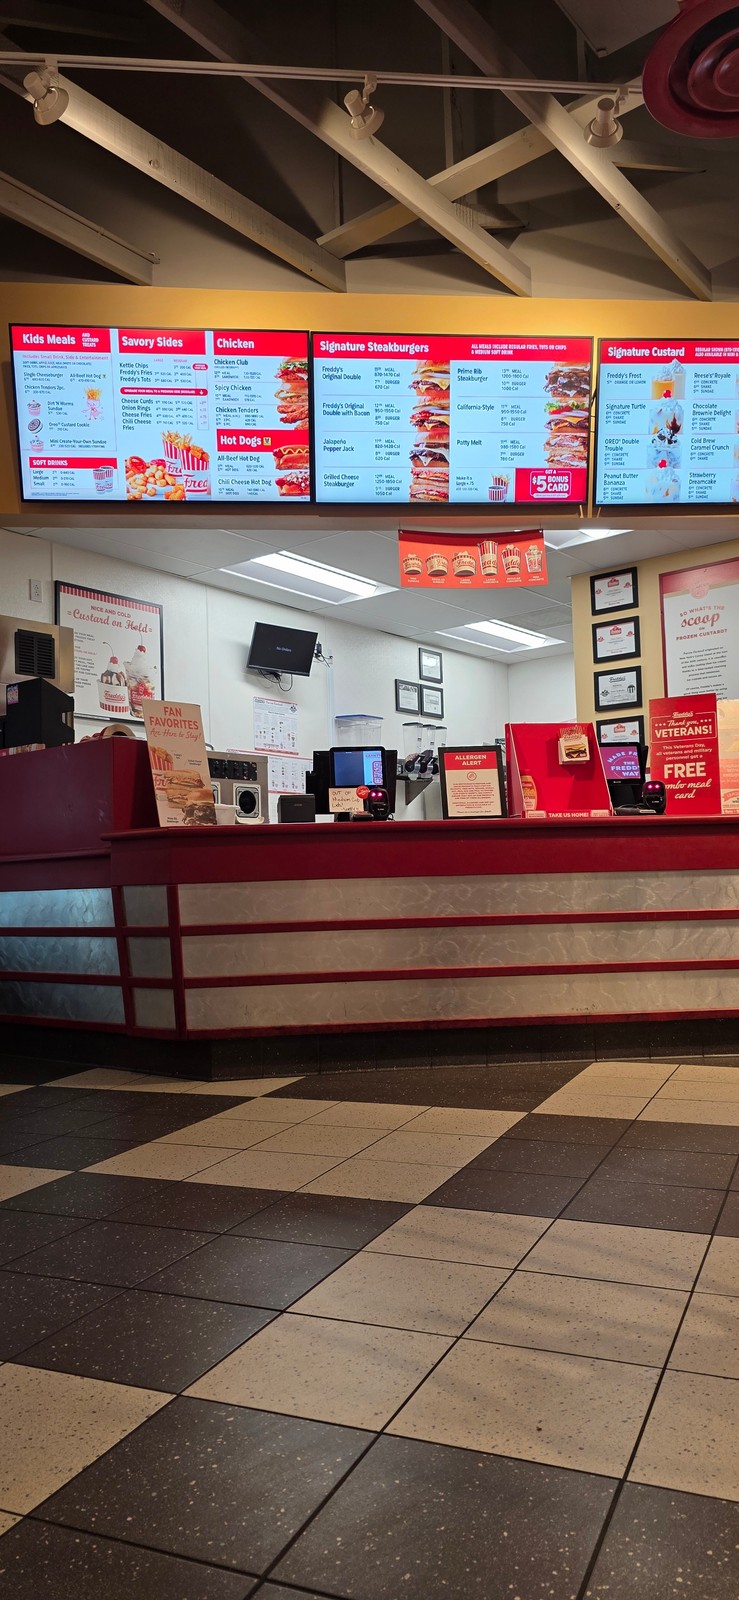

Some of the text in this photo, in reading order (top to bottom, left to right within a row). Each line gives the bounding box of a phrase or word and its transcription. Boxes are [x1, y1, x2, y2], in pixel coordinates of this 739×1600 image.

[22, 333, 76, 345] Kids Meals
[121, 335, 184, 349] Savory Sides
[216, 338, 256, 349] Chicken
[319, 341, 430, 355] Signature Steakburgers
[555, 344, 567, 352] CHIPS
[607, 346, 686, 359] Signature Custard
[322, 373, 342, 381] Original
[457, 375, 488, 383] Steakburger
[214, 384, 230, 392] Spicy
[606, 403, 631, 411] Signature
[220, 435, 262, 448] Hot Dogs
[323, 445, 342, 453] Pepper
[532, 475, 547, 492] $5
[547, 483, 569, 492] CARD
[90, 604, 132, 619] NICE AND COLD
[688, 606, 712, 614] WHAT'S
[73, 608, 149, 634] Custard on Hold
[680, 612, 720, 628] scoop
[676, 628, 728, 641] FROZEN CUSTARD?
[102, 690, 126, 702] Freddy's
[163, 706, 182, 718] FAN
[672, 711, 694, 719] Freddy's
[149, 716, 199, 730] FAVORITES
[685, 720, 699, 729] you,
[150, 728, 202, 742] Are Here to Stay!
[654, 725, 712, 738] VETERANS!
[607, 751, 626, 763] MADE
[663, 762, 706, 779] FREE
[664, 778, 712, 790] mbo meal
[674, 789, 696, 799] card
